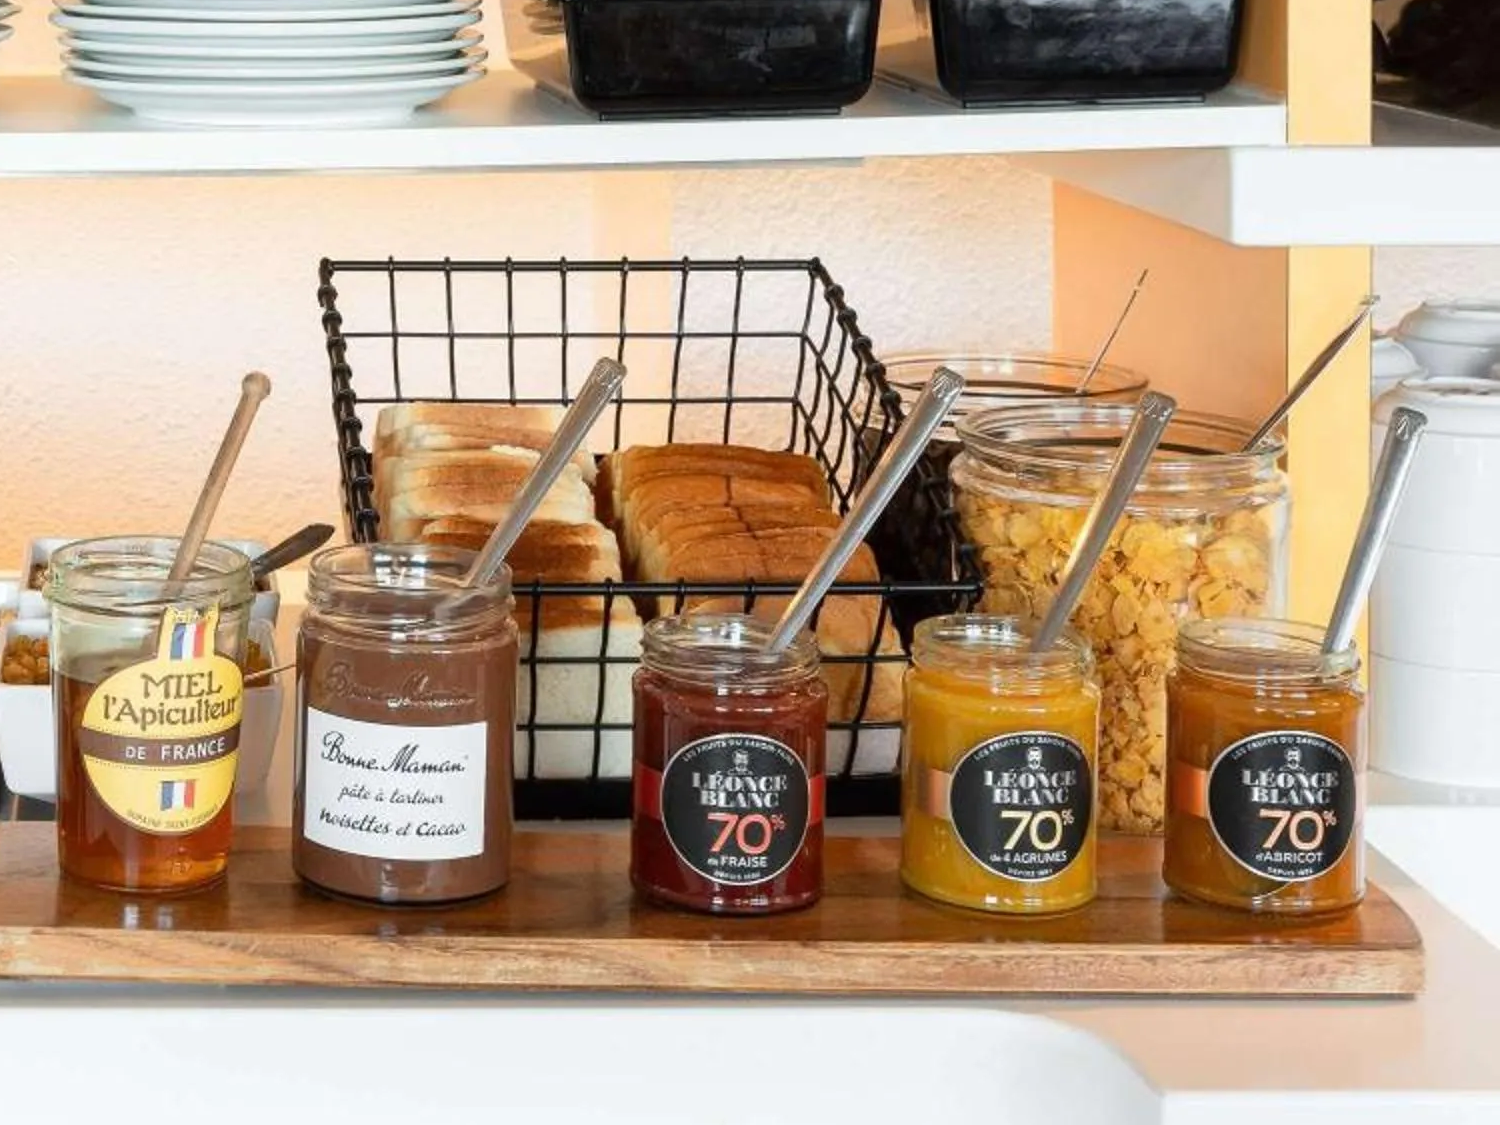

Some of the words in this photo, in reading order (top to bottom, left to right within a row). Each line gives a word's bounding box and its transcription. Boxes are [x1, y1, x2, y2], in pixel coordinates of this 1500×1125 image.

[139, 670, 224, 700] MIEL
[102, 693, 237, 732] l'Apiculteur
[124, 745, 147, 761] DE
[160, 736, 226, 762] FRANCE
[321, 730, 379, 771] Bonne
[381, 742, 466, 774] Maman
[691, 770, 788, 792] LÉONCE
[983, 768, 1077, 789] LÉONCE
[1241, 768, 1340, 789] LÉONCE
[337, 784, 371, 803] pâte
[375, 787, 385, 803] à
[389, 787, 444, 805] tartiner
[700, 789, 780, 808] BLANC
[991, 787, 1070, 806] BLANC
[1250, 786, 1332, 806] BLANC
[395, 823, 409, 837] et
[707, 811, 786, 855] 70%
[1000, 807, 1076, 852] 70%
[1258, 807, 1338, 851] 70%
[720, 855, 769, 868] FRAISE
[1003, 853, 1012, 863] 4
[1013, 850, 1068, 865] AGRUMES
